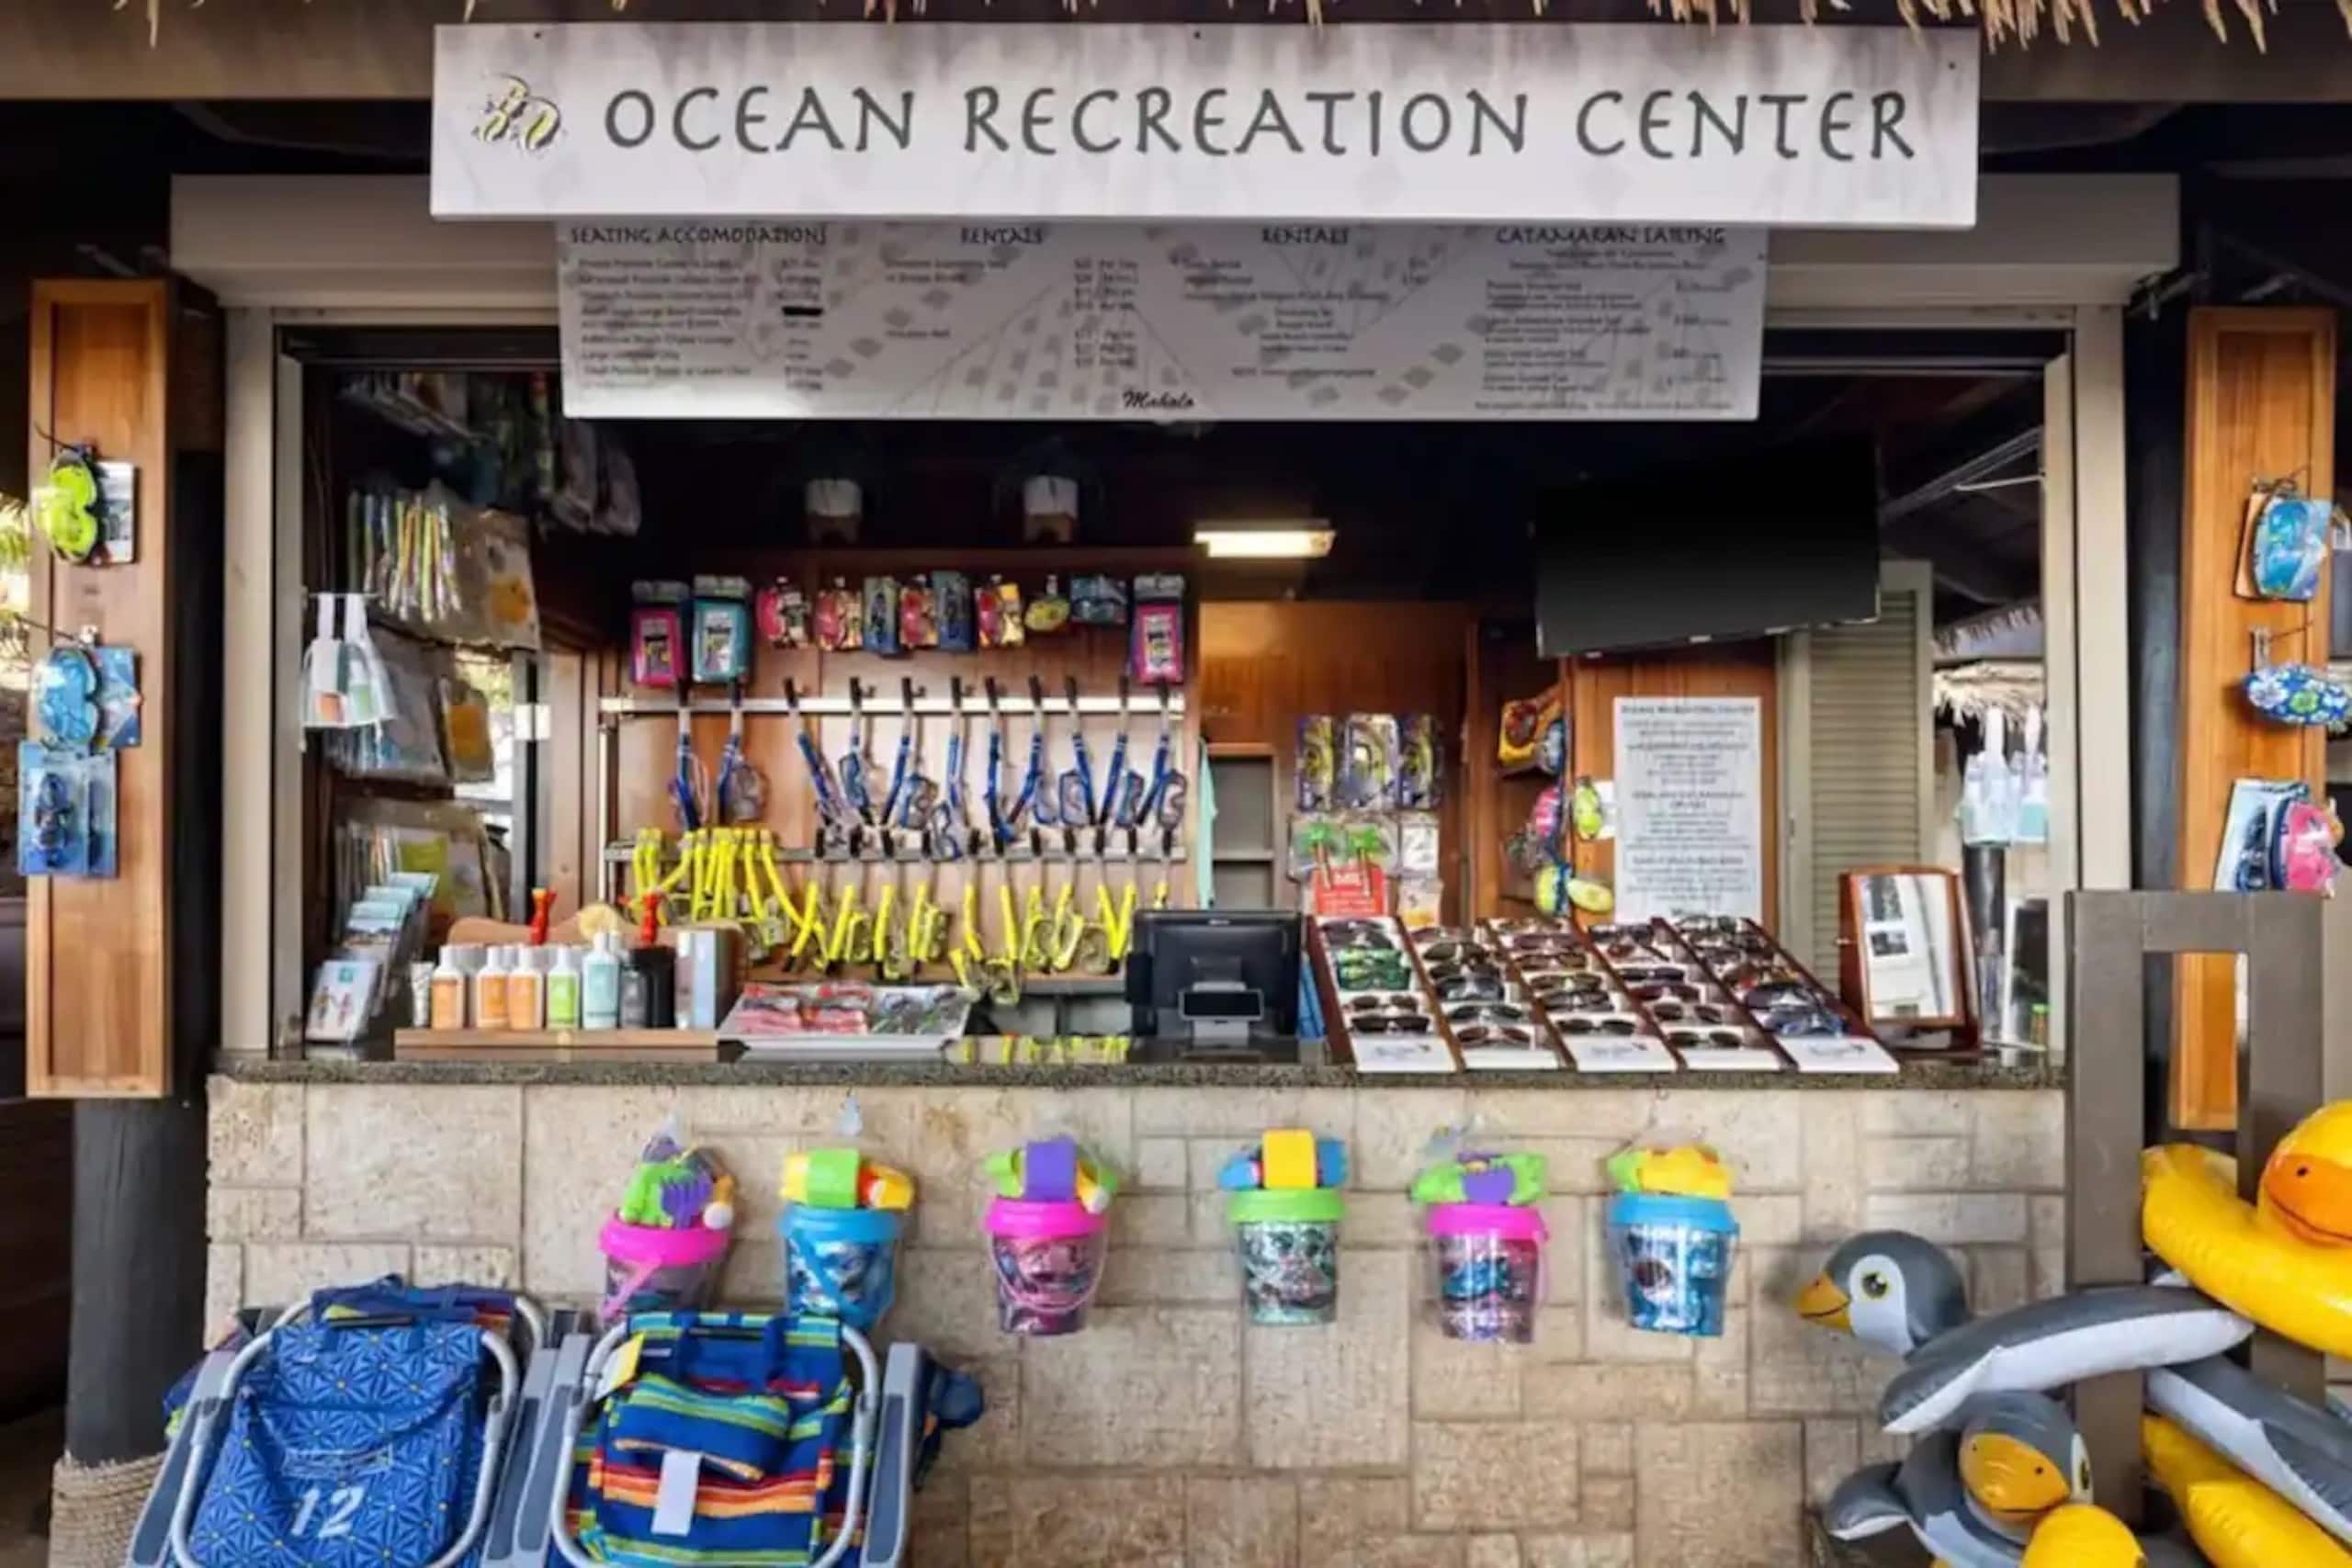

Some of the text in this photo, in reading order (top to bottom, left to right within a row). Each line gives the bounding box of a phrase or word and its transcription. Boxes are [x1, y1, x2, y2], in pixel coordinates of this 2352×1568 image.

[605, 85, 1917, 162] OCEAN RECREATION CENTER
[571, 227, 651, 244] SEATING
[960, 227, 1045, 244] RENTALS
[1261, 227, 1350, 244] RENTALS
[1496, 227, 1639, 244] CATAMARAN
[290, 1486, 367, 1539] 12
